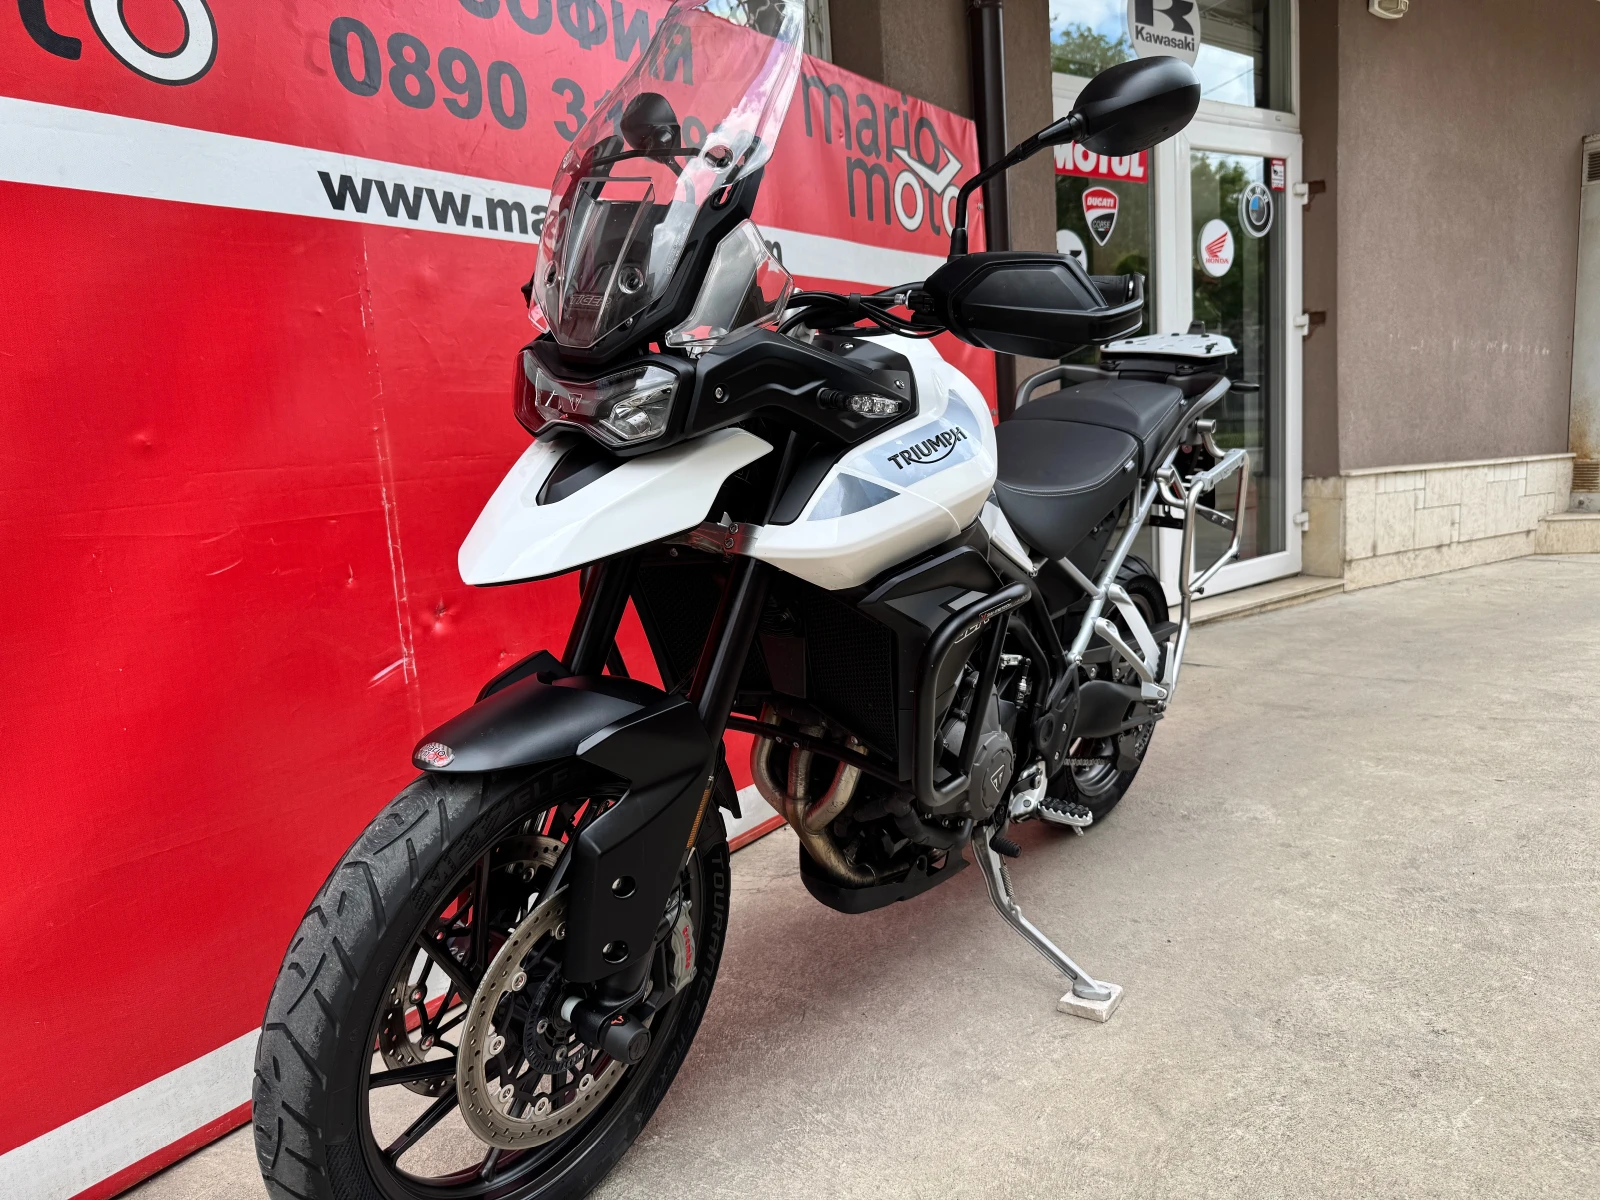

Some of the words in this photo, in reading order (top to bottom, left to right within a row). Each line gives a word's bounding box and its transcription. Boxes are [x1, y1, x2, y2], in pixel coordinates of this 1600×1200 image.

[1135, 24, 1195, 52] Kawasaki
[328, 16, 528, 130] 0890
[801, 71, 941, 172] mario
[1086, 196, 1115, 208] DUCATI
[1092, 220, 1111, 229] CORSE
[1205, 257, 1229, 265] HONDA
[887, 426, 968, 470] TRIUMPH
